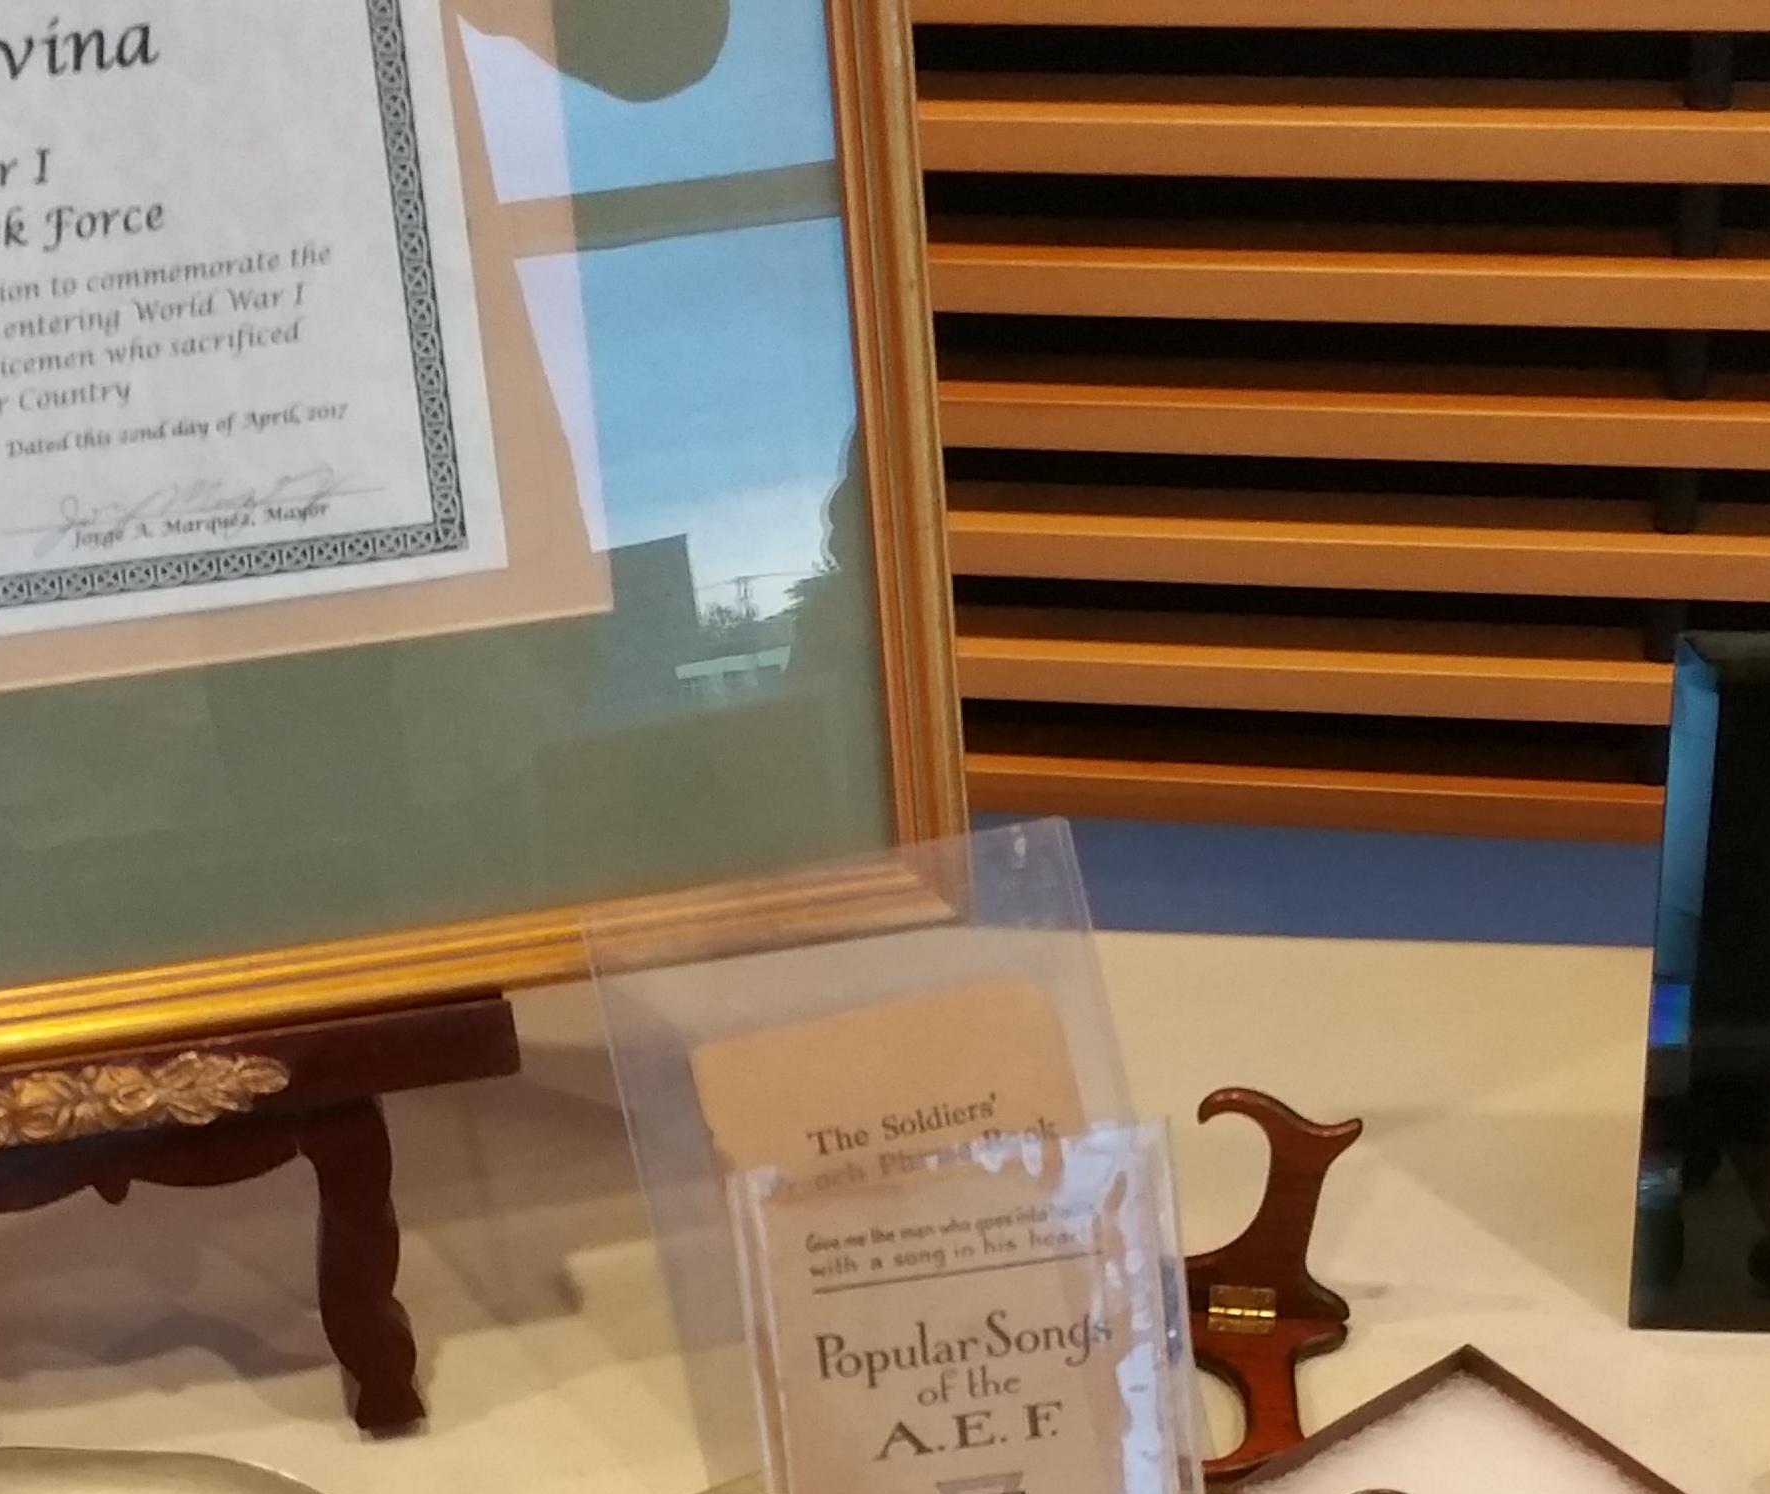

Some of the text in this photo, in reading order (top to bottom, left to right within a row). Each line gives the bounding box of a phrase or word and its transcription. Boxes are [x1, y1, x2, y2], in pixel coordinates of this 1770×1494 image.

[34, 148, 51, 185] I
[43, 200, 166, 253] Force
[51, 274, 77, 298] to
[86, 250, 280, 291] commemorate
[290, 242, 331, 268] the
[3, 308, 120, 338] entering
[129, 296, 214, 324] World
[226, 287, 283, 312] War
[294, 282, 305, 305] I
[105, 337, 161, 365] who
[169, 320, 302, 359] sacrificed
[19, 381, 134, 413] Country
[6, 435, 70, 459] Dated
[75, 426, 112, 449] this
[171, 418, 209, 440] day
[216, 412, 235, 438] of
[307, 403, 349, 422] 2017
[264, 502, 330, 524] Mayor
[806, 1091, 997, 1156] The Soldiers'
[808, 1251, 859, 1277] with
[870, 1257, 883, 1271] a
[893, 1248, 947, 1270] song
[954, 1240, 976, 1257] in
[983, 1233, 1017, 1255] his
[815, 1308, 1112, 1389] Popular Songs
[917, 1364, 1022, 1406] of the
